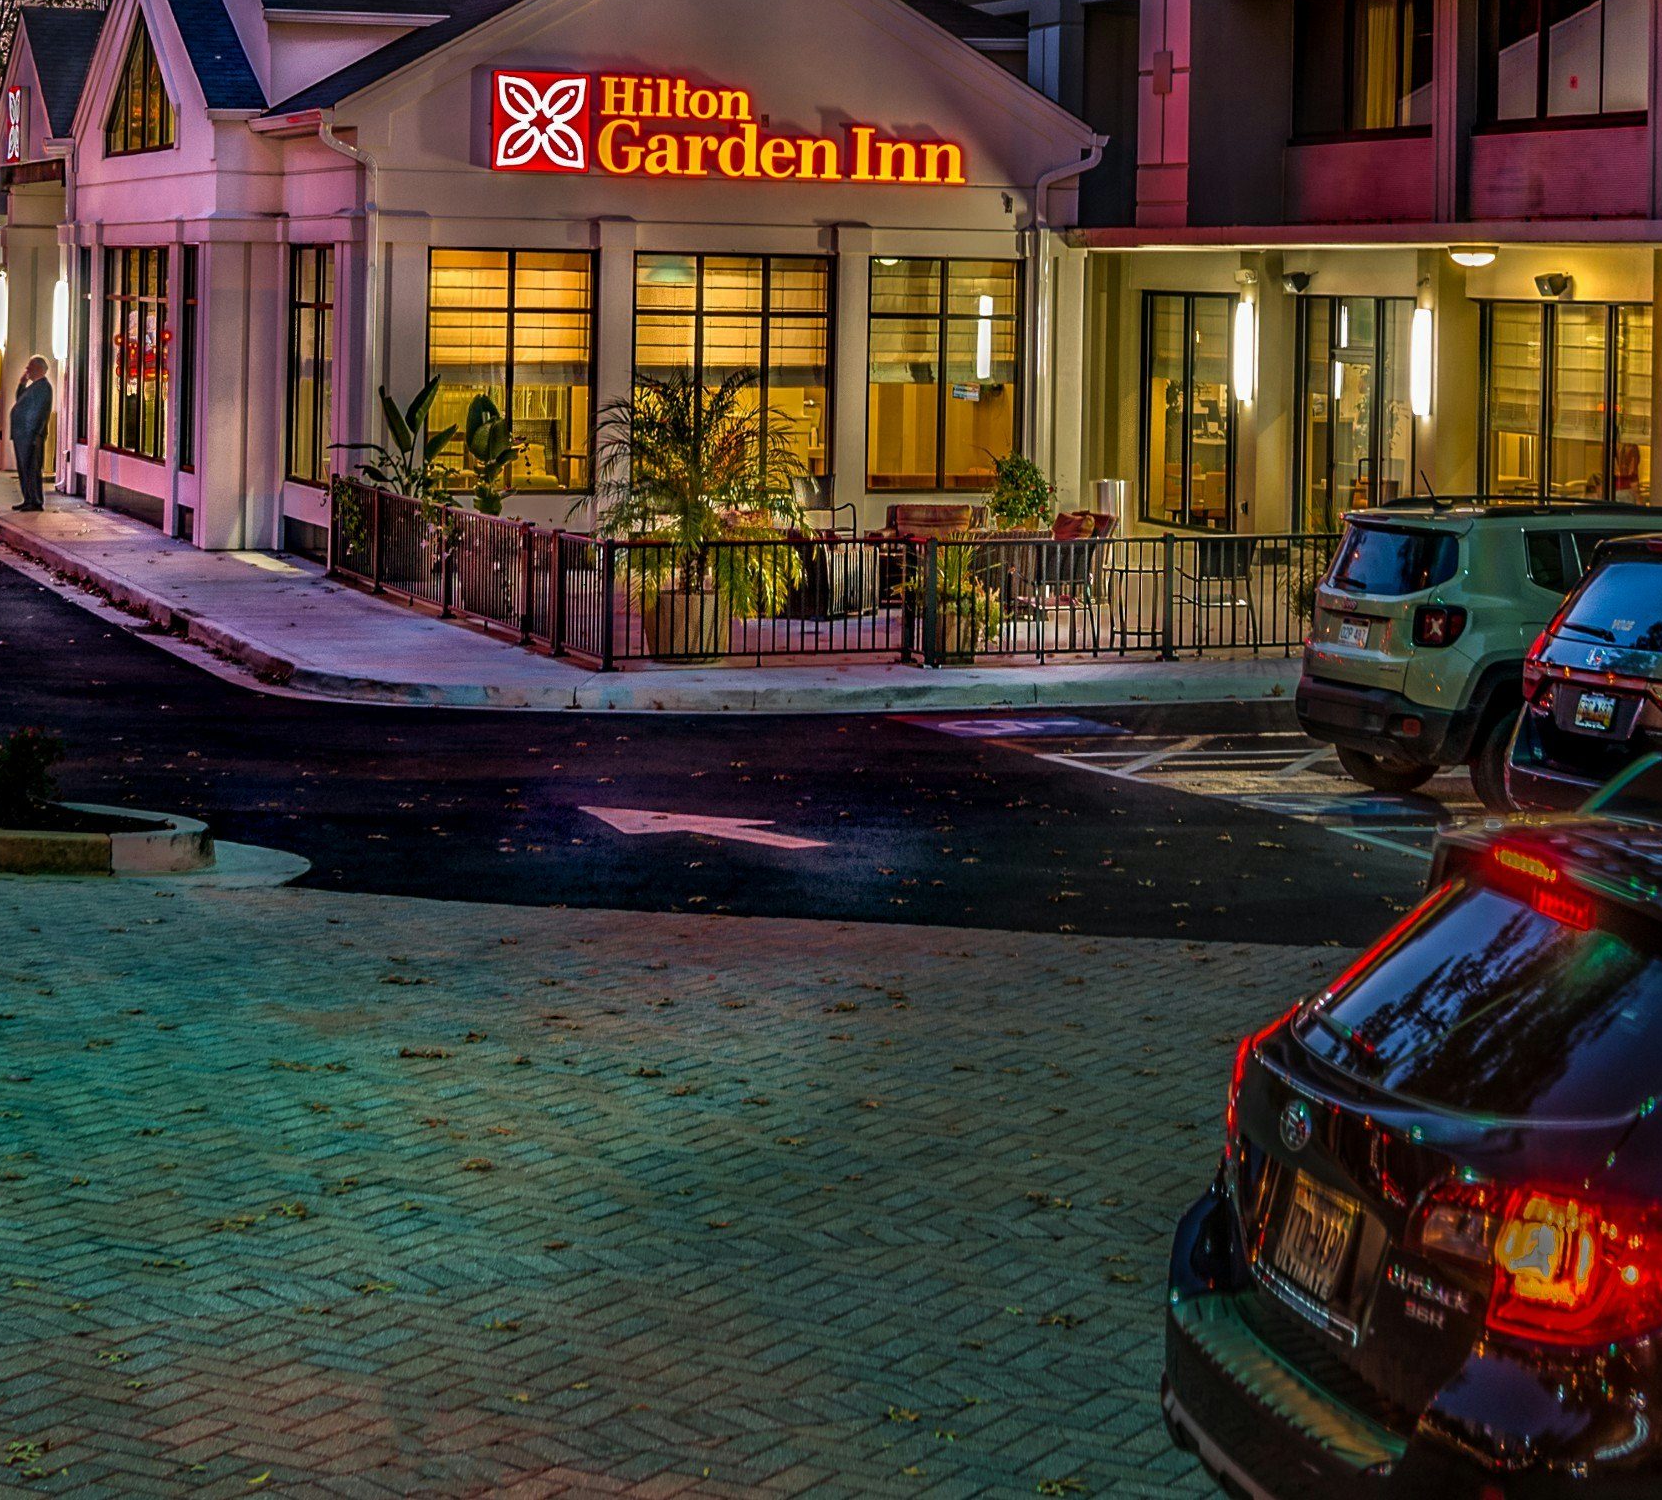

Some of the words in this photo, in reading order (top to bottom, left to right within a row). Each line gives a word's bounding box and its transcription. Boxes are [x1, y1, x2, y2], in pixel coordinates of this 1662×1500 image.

[600, 77, 752, 121] Hilton
[598, 119, 842, 179] Garden
[850, 127, 966, 184] Inn
